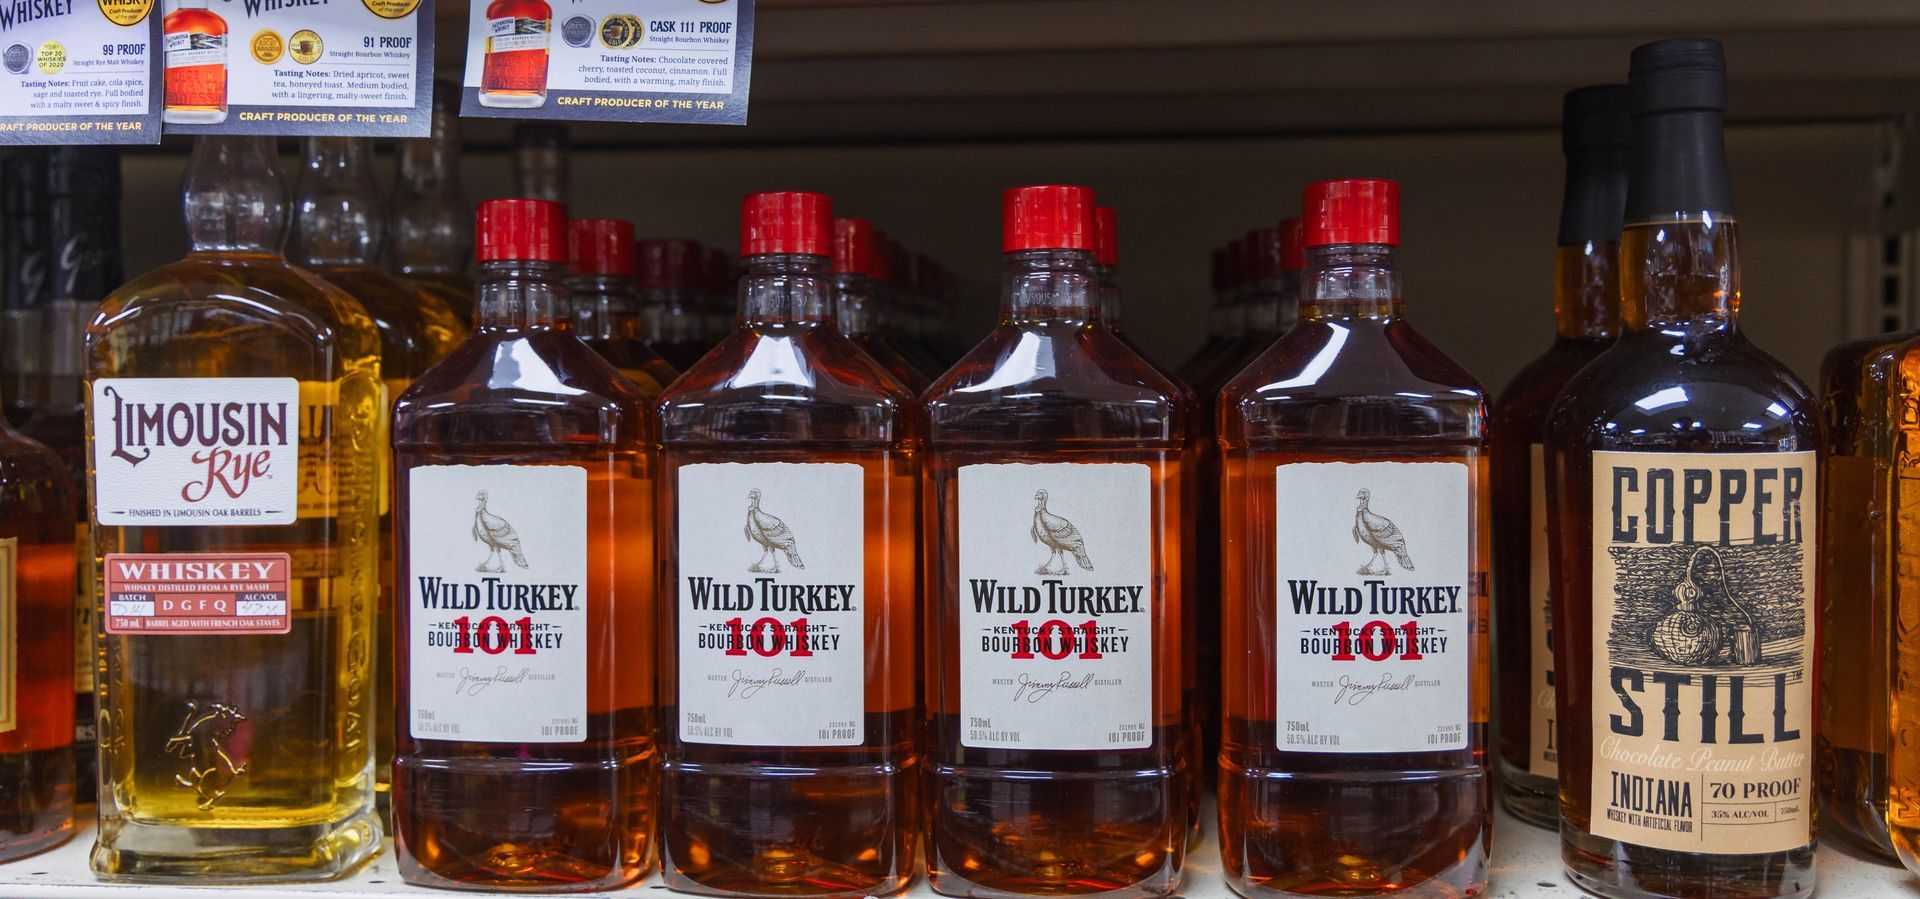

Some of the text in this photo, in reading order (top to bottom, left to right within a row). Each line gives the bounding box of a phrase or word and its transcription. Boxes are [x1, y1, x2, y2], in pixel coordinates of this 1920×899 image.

[650, 21, 732, 33] CASK 111 PROOF
[363, 37, 412, 48] 91 PROOF
[649, 36, 673, 44] Straight
[103, 44, 145, 55] 99 PROOF
[329, 50, 353, 59] Straight
[600, 55, 629, 63] Tasting
[632, 55, 656, 63] Notes:
[698, 57, 728, 65] covered
[273, 70, 303, 78] Tasting
[357, 72, 385, 80] apricot,
[578, 65, 604, 74] cherry,
[606, 66, 634, 74] toasted
[636, 67, 668, 75] coconut,
[669, 67, 709, 75] cinnamon.
[289, 81, 322, 89] honeyed
[381, 82, 409, 90] bodied,
[584, 76, 612, 84] bodied,
[640, 78, 676, 86] warming,
[678, 78, 700, 87] malty
[702, 78, 726, 86] finish.
[298, 91, 334, 100] lingering,
[336, 92, 382, 100] malty-sweet
[385, 92, 409, 100] finish.
[53, 101, 72, 109] malty
[557, 97, 724, 109] CRAFT PRODUCER OF THE YEAR
[239, 112, 408, 123] CRAFT PRODUCER OF THE YEAR
[0, 123, 23, 131] RAFT
[96, 122, 114, 130] THE
[116, 122, 142, 130] YEAR
[104, 386, 288, 468] LIMOUSIN
[182, 446, 270, 502] Rye
[1612, 466, 1803, 547] COPPER
[129, 509, 161, 517] FINISHED
[163, 509, 171, 517] IN
[174, 509, 210, 517] LIMOUSIN
[118, 562, 275, 580] WHISKEY
[419, 576, 578, 614] WILD TURKEY
[688, 577, 855, 614] WILD TURKEY
[969, 579, 1144, 616] WILD TURKEY
[1288, 580, 1363, 614] WILD
[1364, 580, 1461, 617] TURKEY
[163, 600, 227, 613] D G F Q
[770, 624, 827, 632] STRAIGHT
[994, 626, 1054, 634] KENTUCKY
[1380, 627, 1436, 635] STRAIGHT
[428, 631, 564, 649] BOURBON WHISKEY
[453, 616, 537, 655] 101
[699, 633, 840, 650] BOURBON WHISKEY
[725, 617, 813, 657] 101
[1011, 620, 1103, 660] 101
[1331, 620, 1423, 661] 101
[982, 636, 1129, 653] BOURBON WHISKEY
[1301, 637, 1448, 654] BOURBON WHISKEY
[1609, 666, 1801, 744] STILL
[970, 718, 991, 728] 750mL
[970, 730, 1021, 742] 50.5% ALC BY VOL
[1108, 731, 1145, 743] 101 PROOF
[1600, 736, 1806, 772] Chocolate Peanut Butter
[1710, 777, 1802, 798] 70 PROOF
[1611, 771, 1693, 818] INDIANA
[1711, 810, 1768, 818] 35% ALC/VOL
[1607, 808, 1693, 833] WHISKEY WITH ARTIFICIAL FLAVOR
